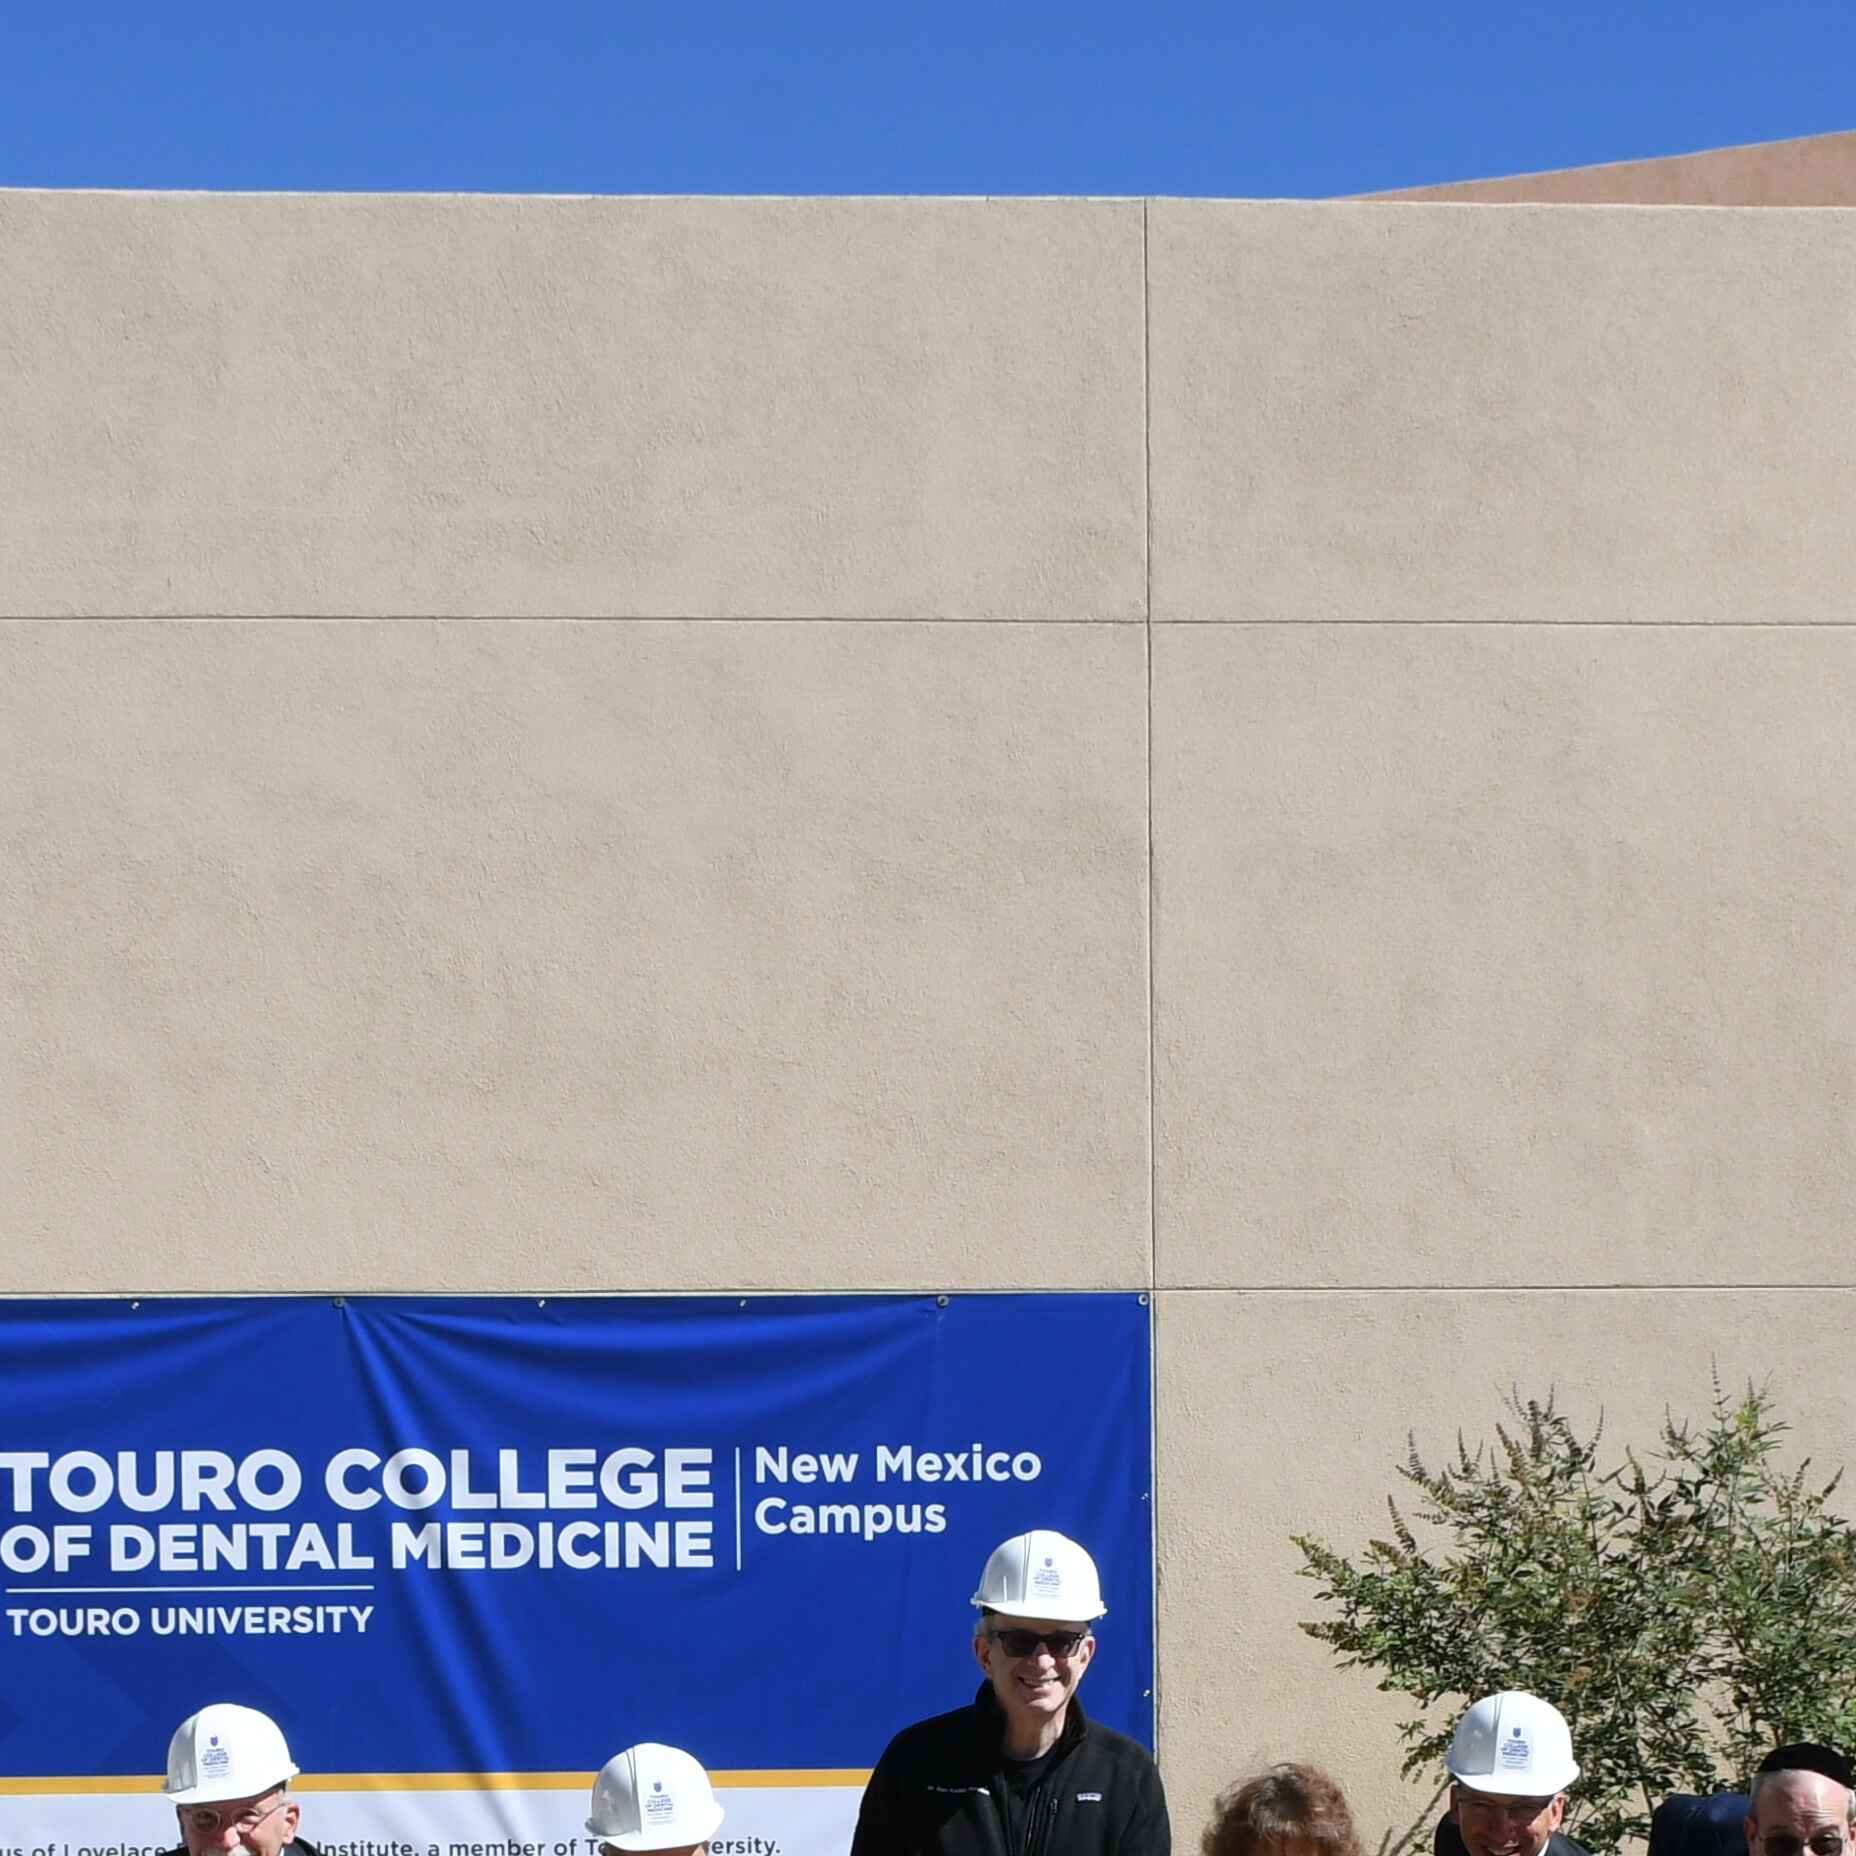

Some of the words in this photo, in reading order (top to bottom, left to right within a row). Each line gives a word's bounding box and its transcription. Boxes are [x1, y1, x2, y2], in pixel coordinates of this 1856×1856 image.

[324, 1447, 714, 1511] COLLEGE
[754, 1446, 860, 1484] New
[875, 1443, 1043, 1482] Mexico
[753, 1497, 948, 1541] Campus
[0, 1524, 93, 1573] OF
[109, 1522, 376, 1572] DENTAL
[391, 1520, 715, 1569] MEDICINE
[5, 1607, 140, 1636] TOURO
[151, 1605, 375, 1635] UNIVERSITY
